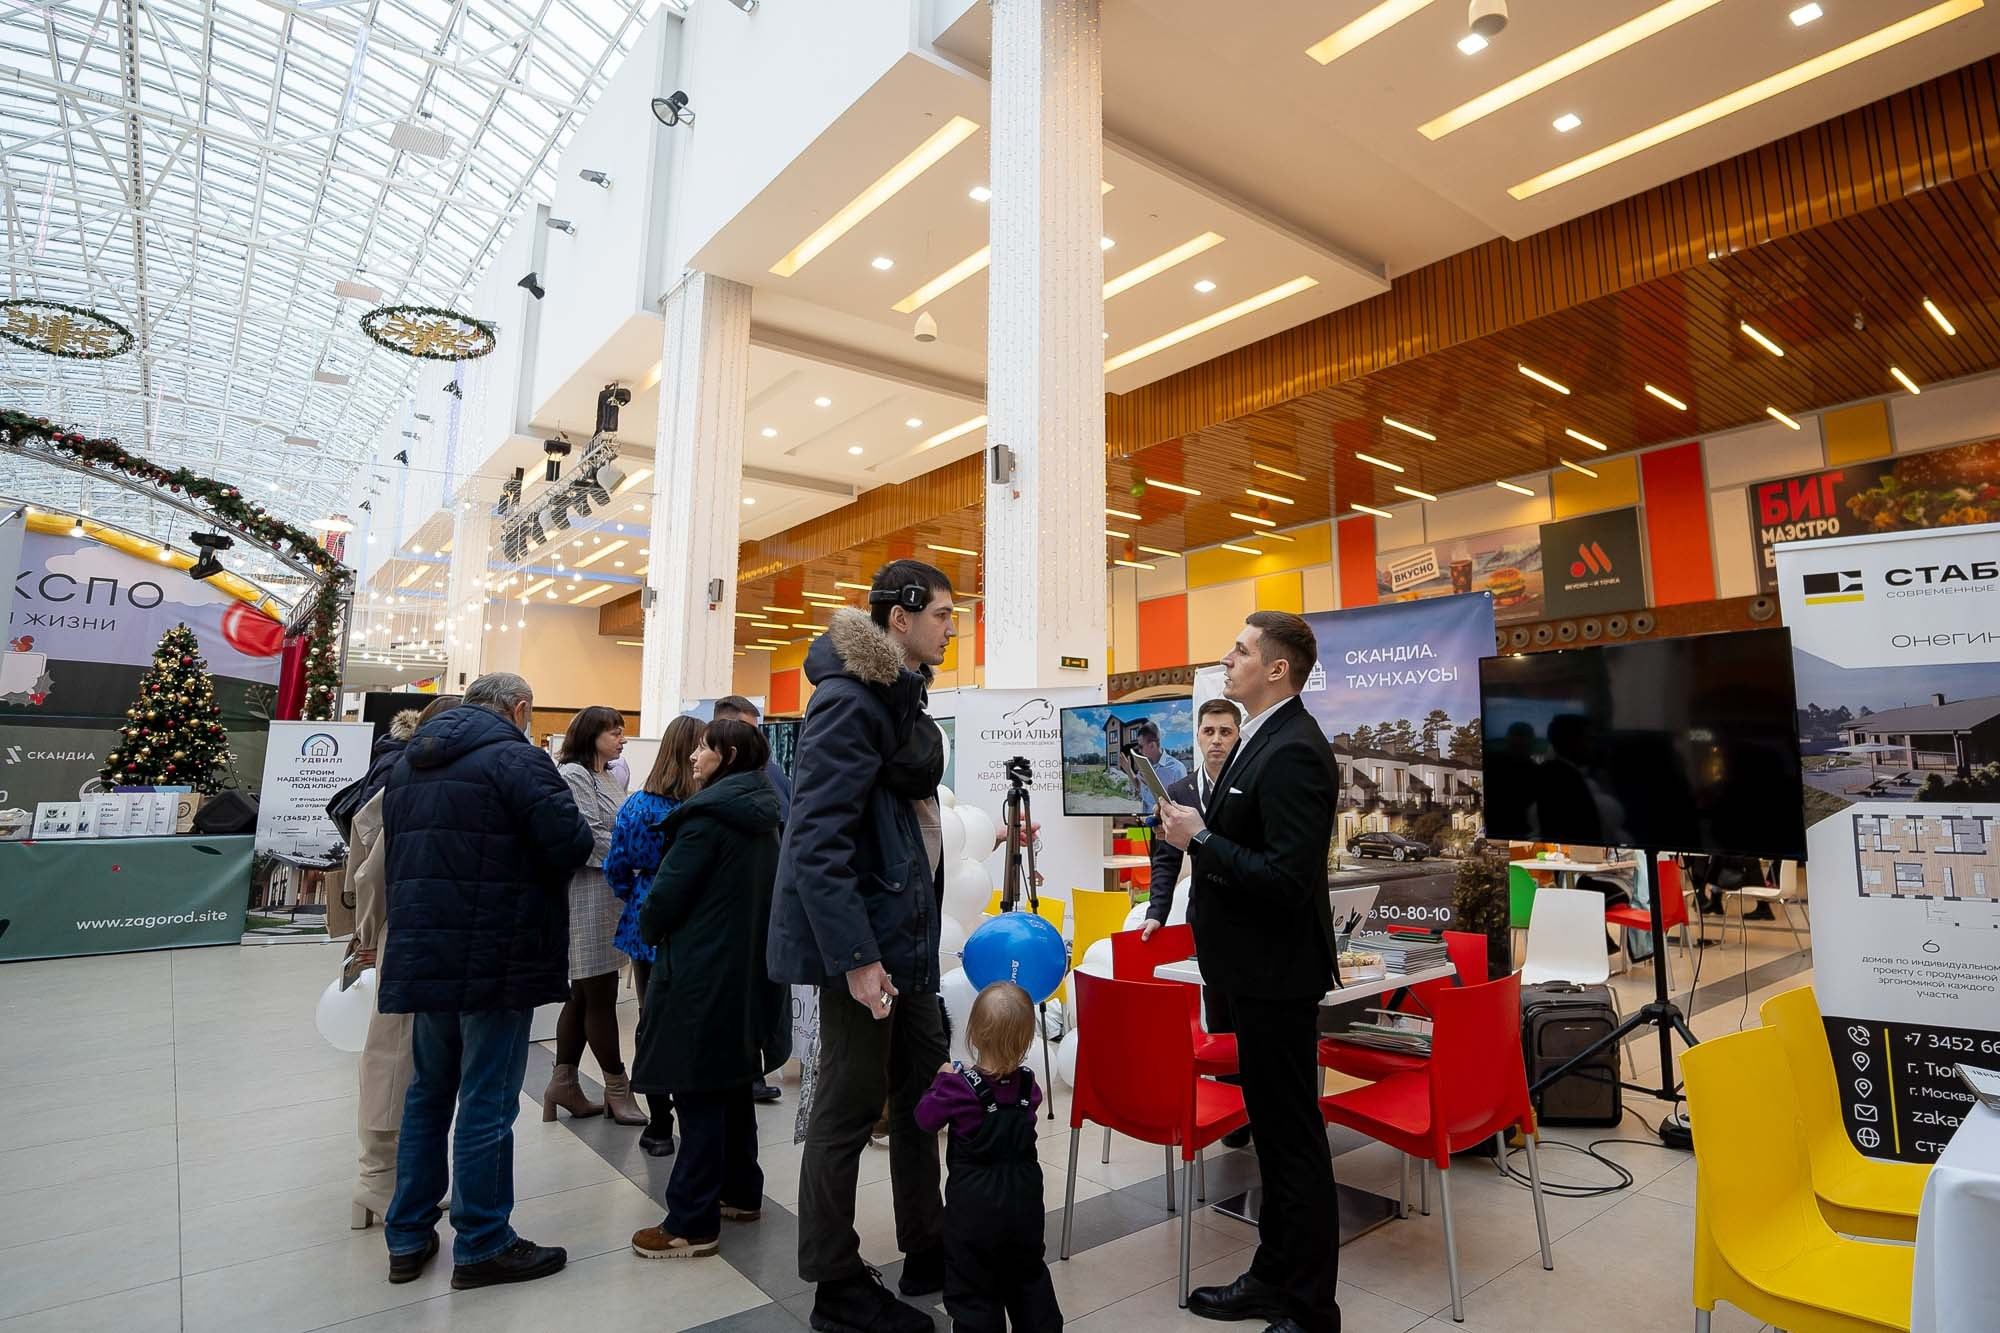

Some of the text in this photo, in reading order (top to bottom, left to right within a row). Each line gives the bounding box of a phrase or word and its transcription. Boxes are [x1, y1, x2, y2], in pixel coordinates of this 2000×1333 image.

[1758, 471, 1844, 526] БИГ
[1761, 517, 1840, 544] МАЭСТРО
[1394, 563, 1434, 583] ВКУСНО
[1885, 561, 1999, 586] СТАБ
[1886, 585, 1996, 598] СОВРЕМЕННЫЕ
[24, 613, 116, 631] ЖИЗНИ
[1345, 644, 1437, 664] СКАНДИА.
[1346, 666, 1458, 688] ТАУНХАУСЫ
[981, 728, 1022, 740] СТРОЙ
[27, 751, 96, 760] СКАНДИА
[76, 910, 228, 930] www.zagorod.site
[1380, 905, 1451, 922] 50-80-10
[1922, 939, 1940, 953] 6
[1862, 956, 1893, 964] домов
[1873, 967, 1914, 977] проекту
[1926, 970, 1998, 982] продуманной
[1878, 977, 1995, 993] эргономикой каждого
[1916, 990, 1959, 1000] участка
[1904, 1033, 1921, 1046] +7
[1928, 1034, 1975, 1052] 3452
[1921, 1086, 1976, 1103] Москва
